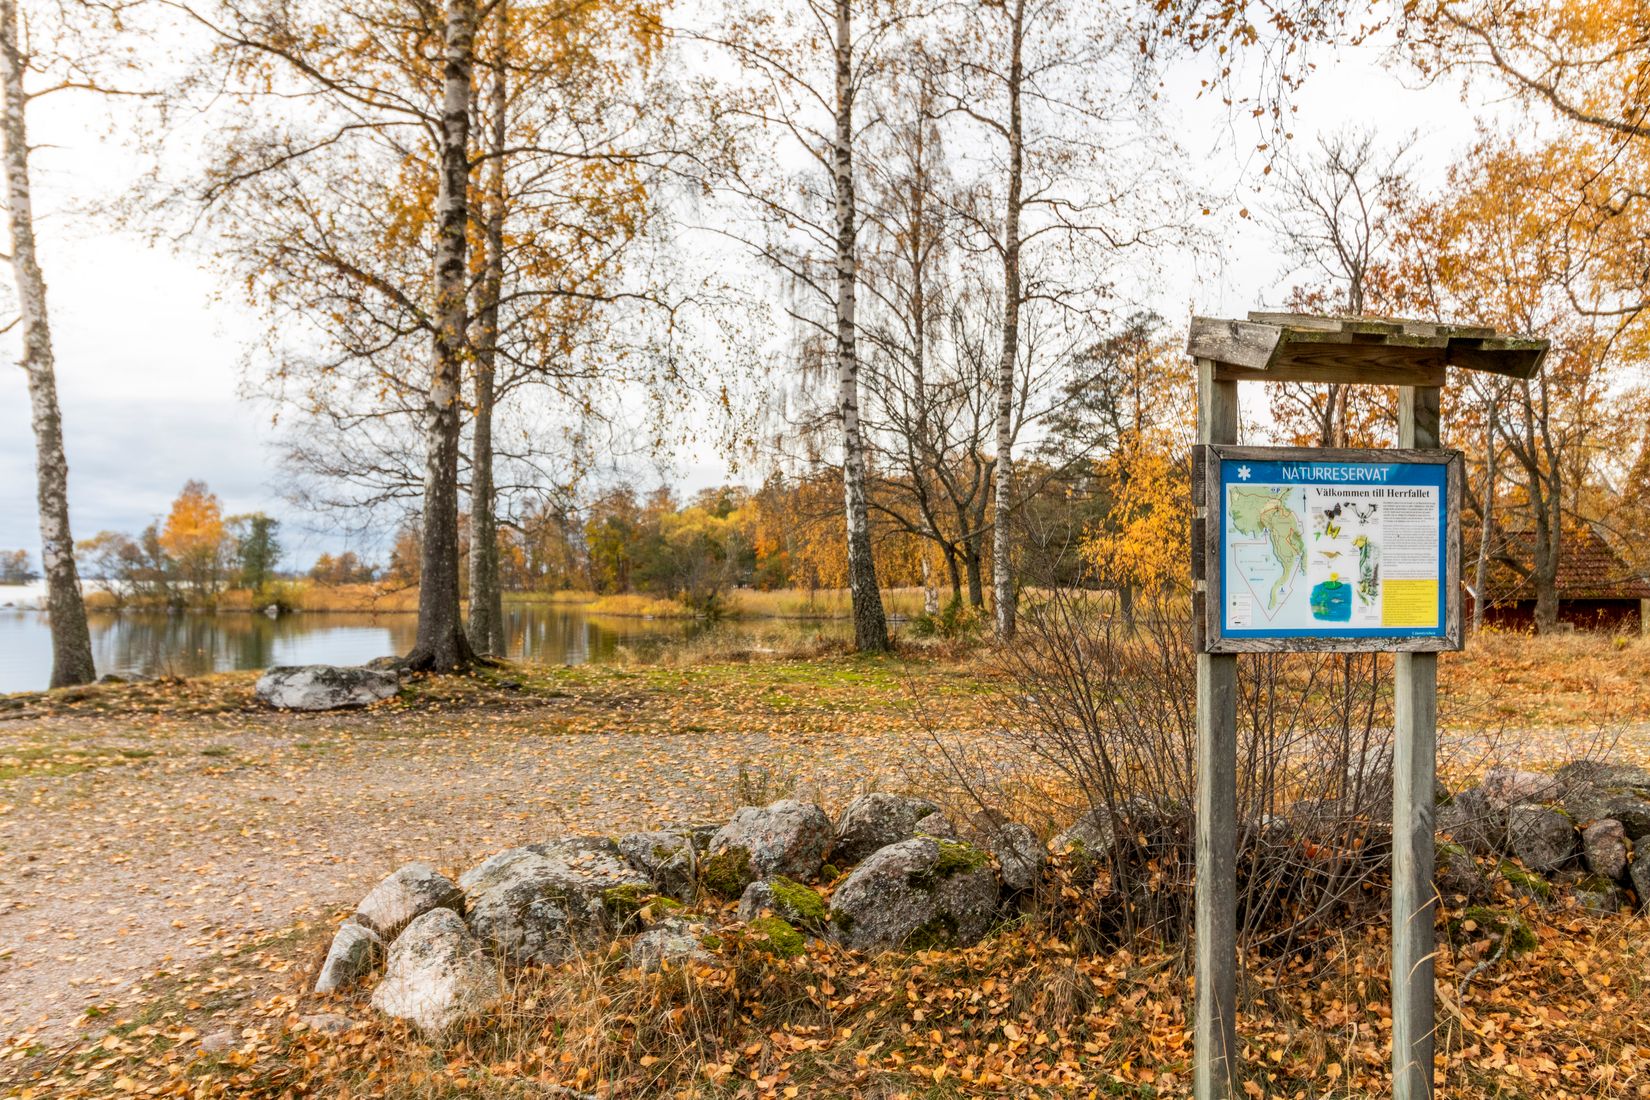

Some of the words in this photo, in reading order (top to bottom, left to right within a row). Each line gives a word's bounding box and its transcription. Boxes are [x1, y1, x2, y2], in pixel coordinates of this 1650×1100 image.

[1282, 467, 1390, 481] NATURRESERVAT
[1316, 487, 1370, 498] Välkommen
[1372, 488, 1385, 498] till
[1387, 488, 1430, 498] Herrfallet
